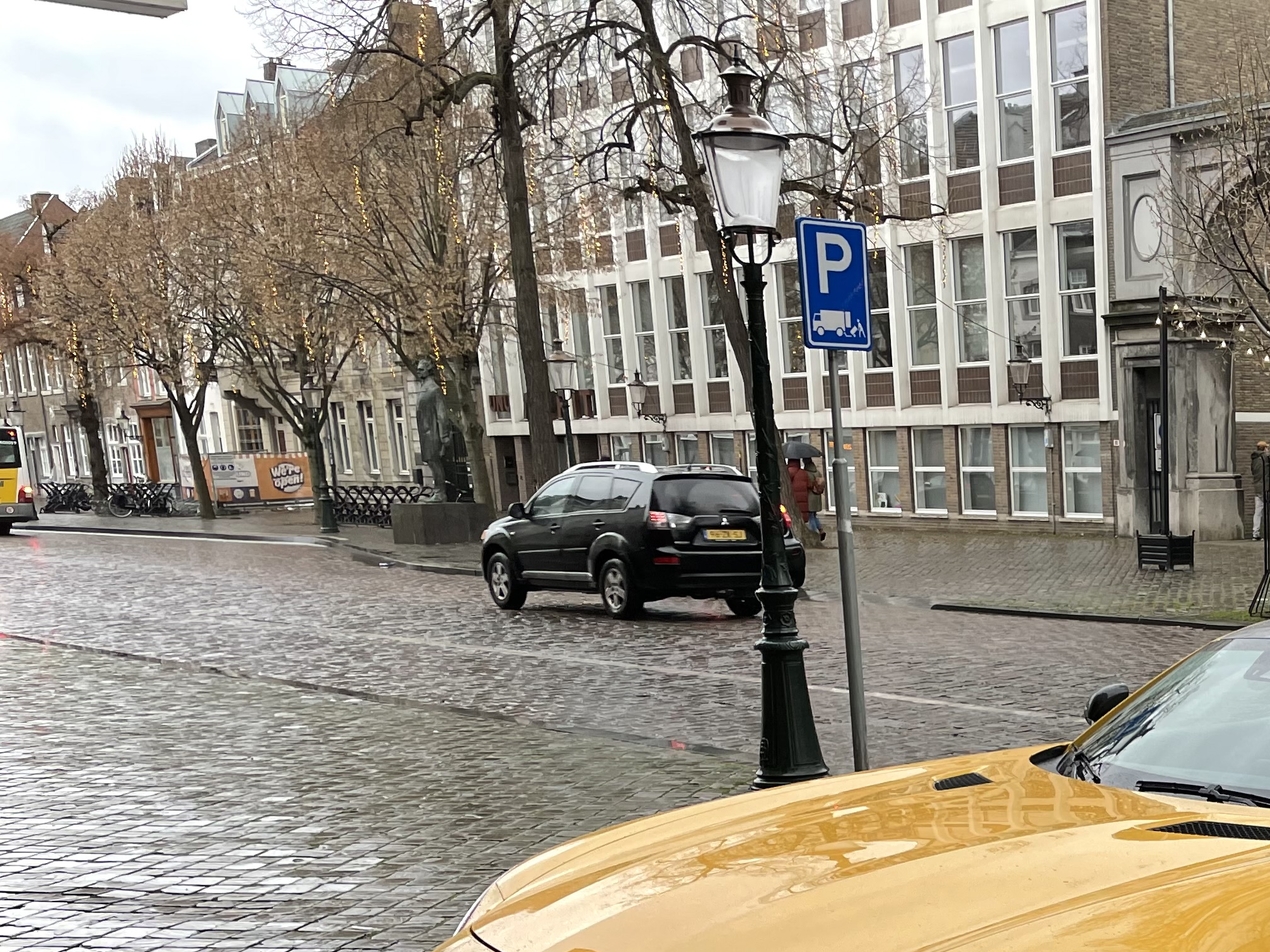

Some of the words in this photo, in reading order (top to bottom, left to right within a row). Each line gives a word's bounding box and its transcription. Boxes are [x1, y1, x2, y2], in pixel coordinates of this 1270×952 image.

[815, 231, 853, 294] P
[270, 463, 301, 478] We're
[273, 472, 304, 489] open!
